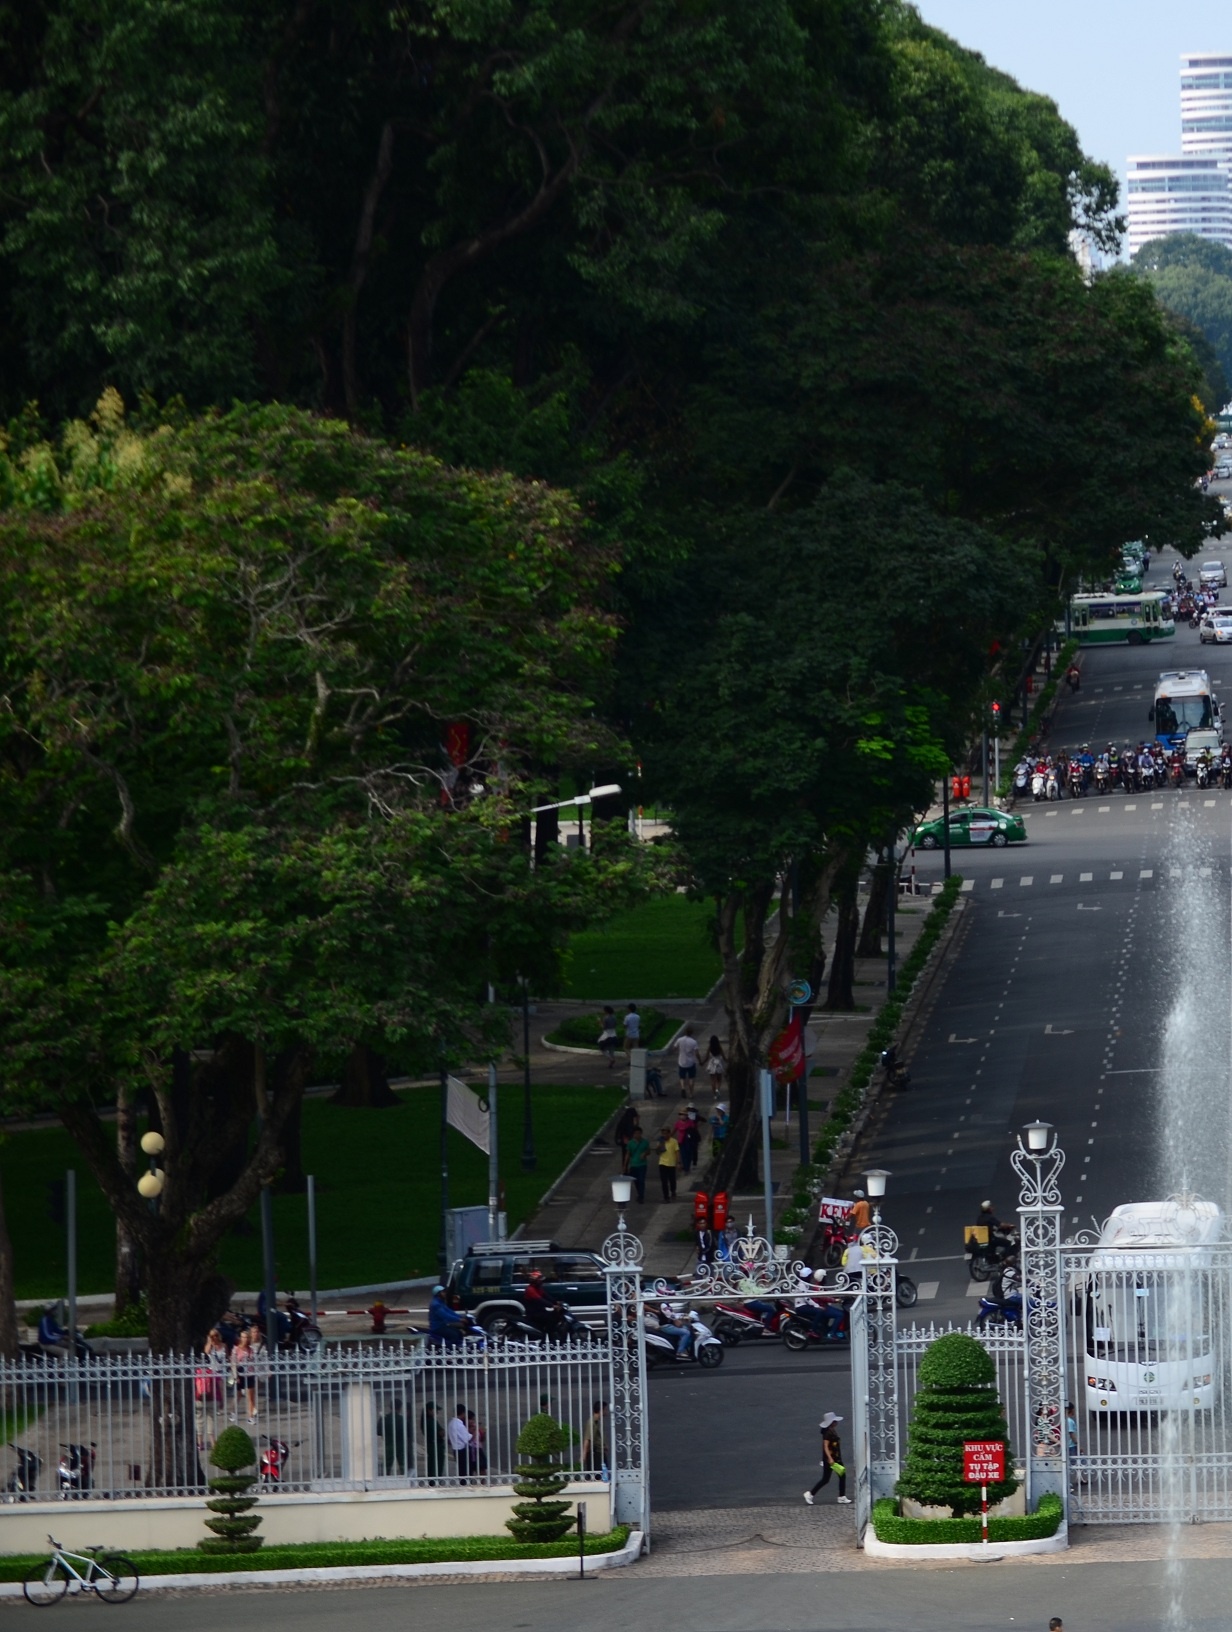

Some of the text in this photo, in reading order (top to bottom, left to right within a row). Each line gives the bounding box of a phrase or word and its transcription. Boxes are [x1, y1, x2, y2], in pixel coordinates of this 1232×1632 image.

[965, 1443, 1003, 1453] KHU VỰC
[973, 1450, 993, 1461] CẤM
[987, 1471, 1000, 1479] XE
